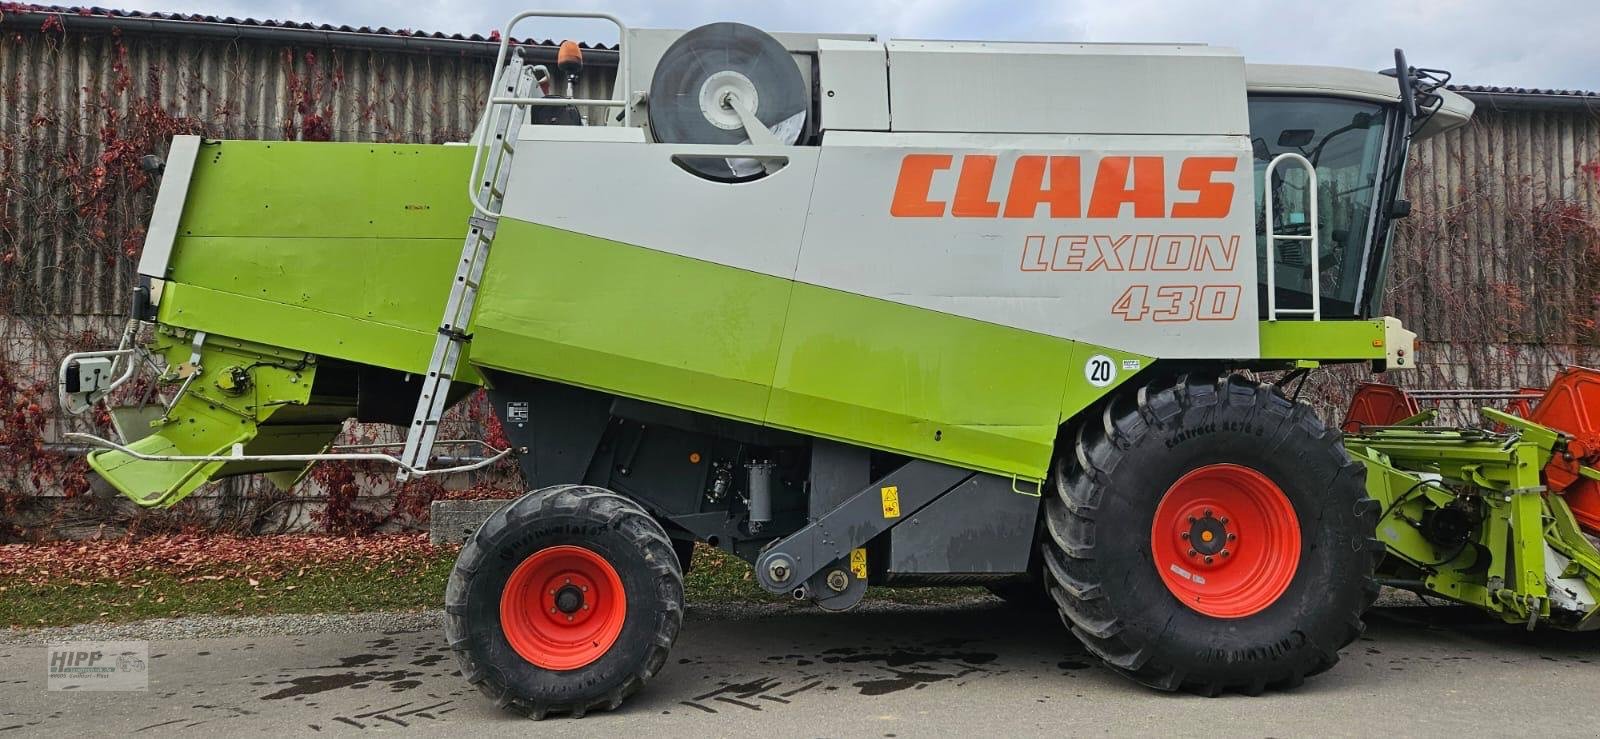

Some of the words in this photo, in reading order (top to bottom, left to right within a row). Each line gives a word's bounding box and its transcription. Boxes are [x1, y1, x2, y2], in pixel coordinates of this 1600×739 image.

[890, 154, 1237, 218] CLAAS
[1020, 235, 1240, 272] LEXION
[1111, 285, 1241, 321] 430
[1091, 360, 1110, 382] 20
